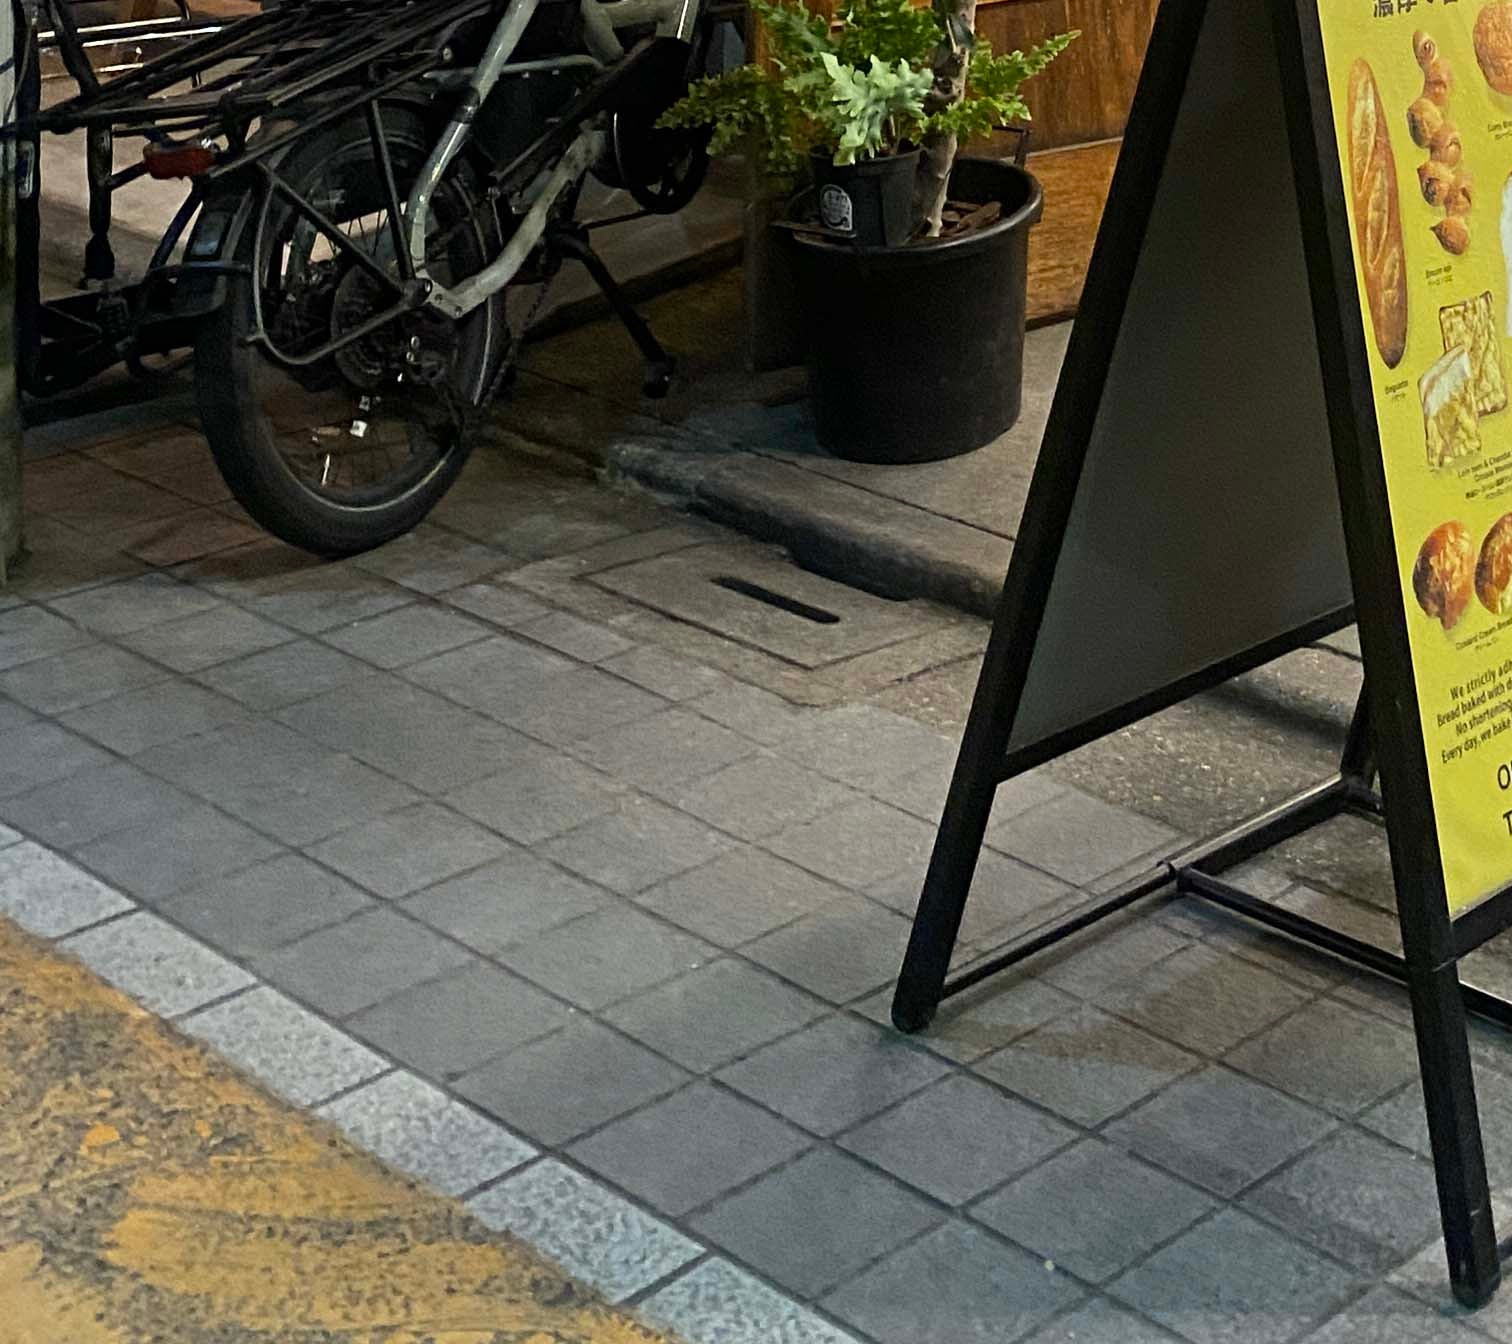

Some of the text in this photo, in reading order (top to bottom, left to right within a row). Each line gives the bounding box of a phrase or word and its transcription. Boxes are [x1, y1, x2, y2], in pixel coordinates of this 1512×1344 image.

[1450, 683, 1464, 702] We
[1465, 666, 1495, 694] strictly
[1436, 703, 1460, 727] Bread
[1460, 690, 1486, 715] baked
[1486, 680, 1505, 701] with
[1441, 741, 1462, 764] Every
